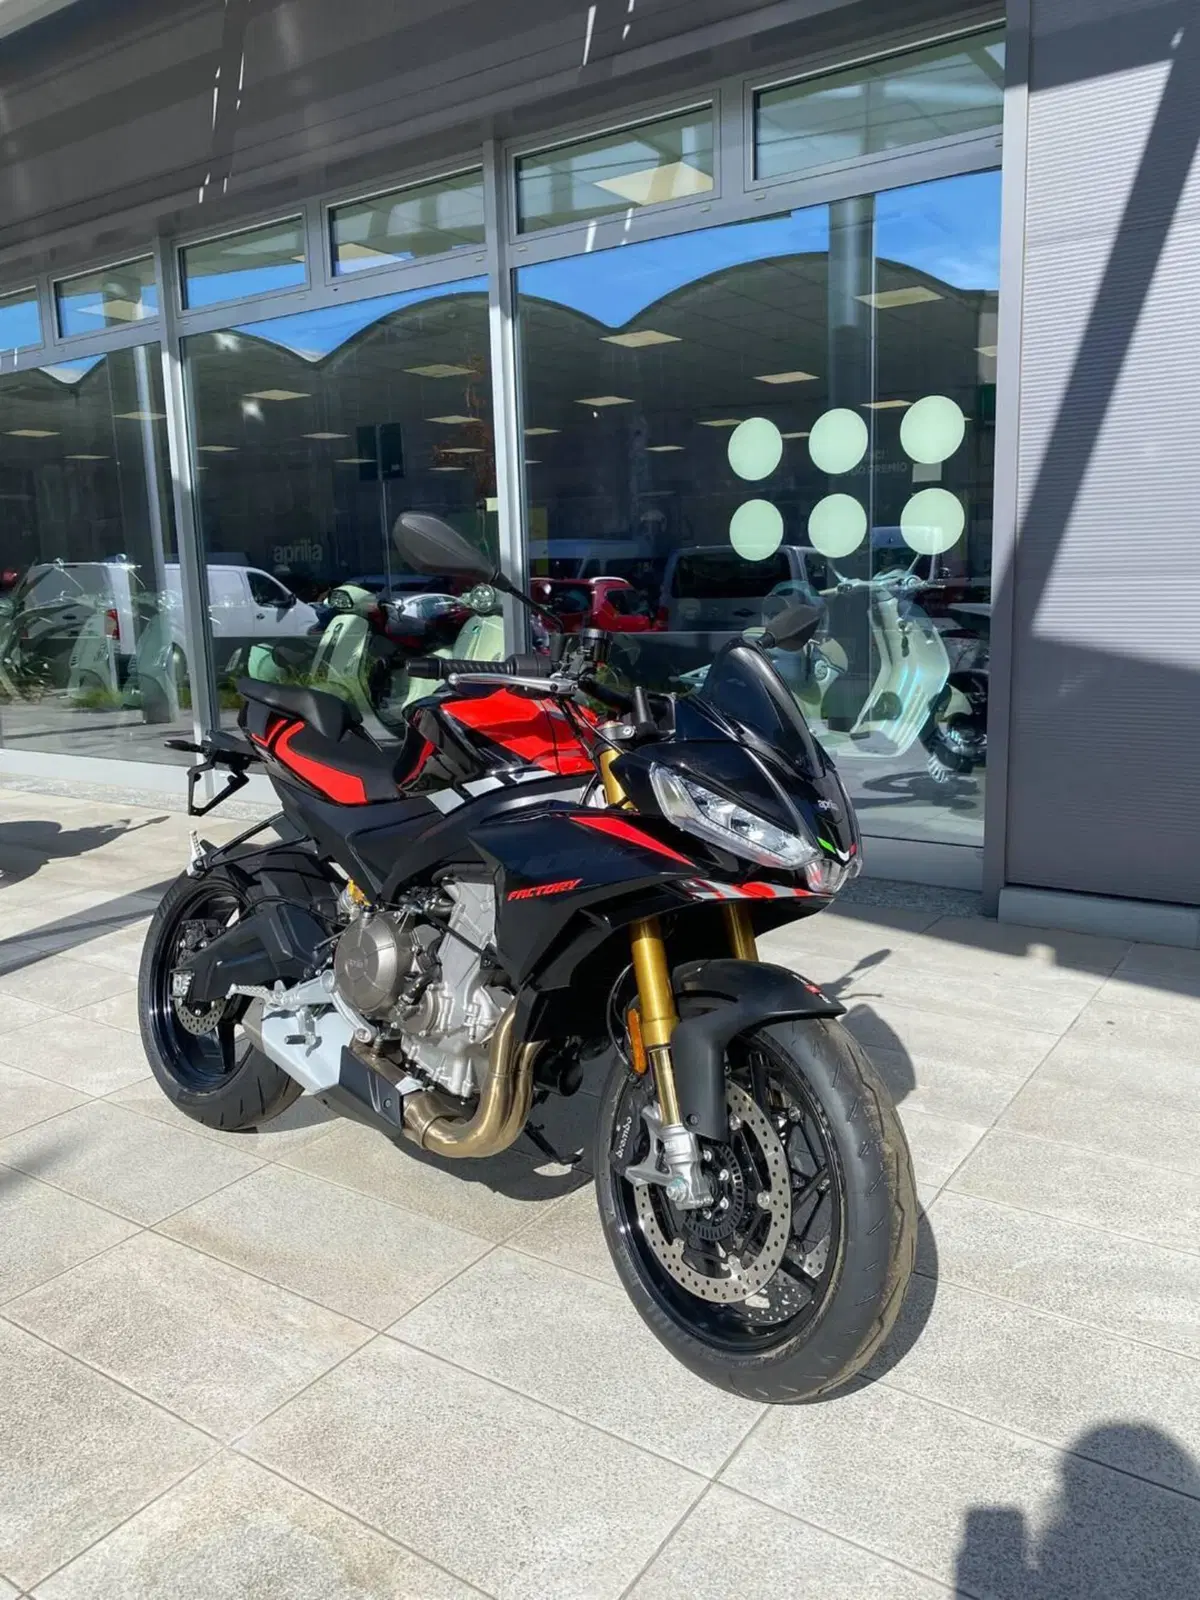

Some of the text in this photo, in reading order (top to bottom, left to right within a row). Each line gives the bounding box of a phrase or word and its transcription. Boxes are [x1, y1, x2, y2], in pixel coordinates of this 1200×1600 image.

[272, 538, 324, 567] aprilia
[507, 877, 583, 902] FACTORY
[615, 1116, 633, 1159] brembo
